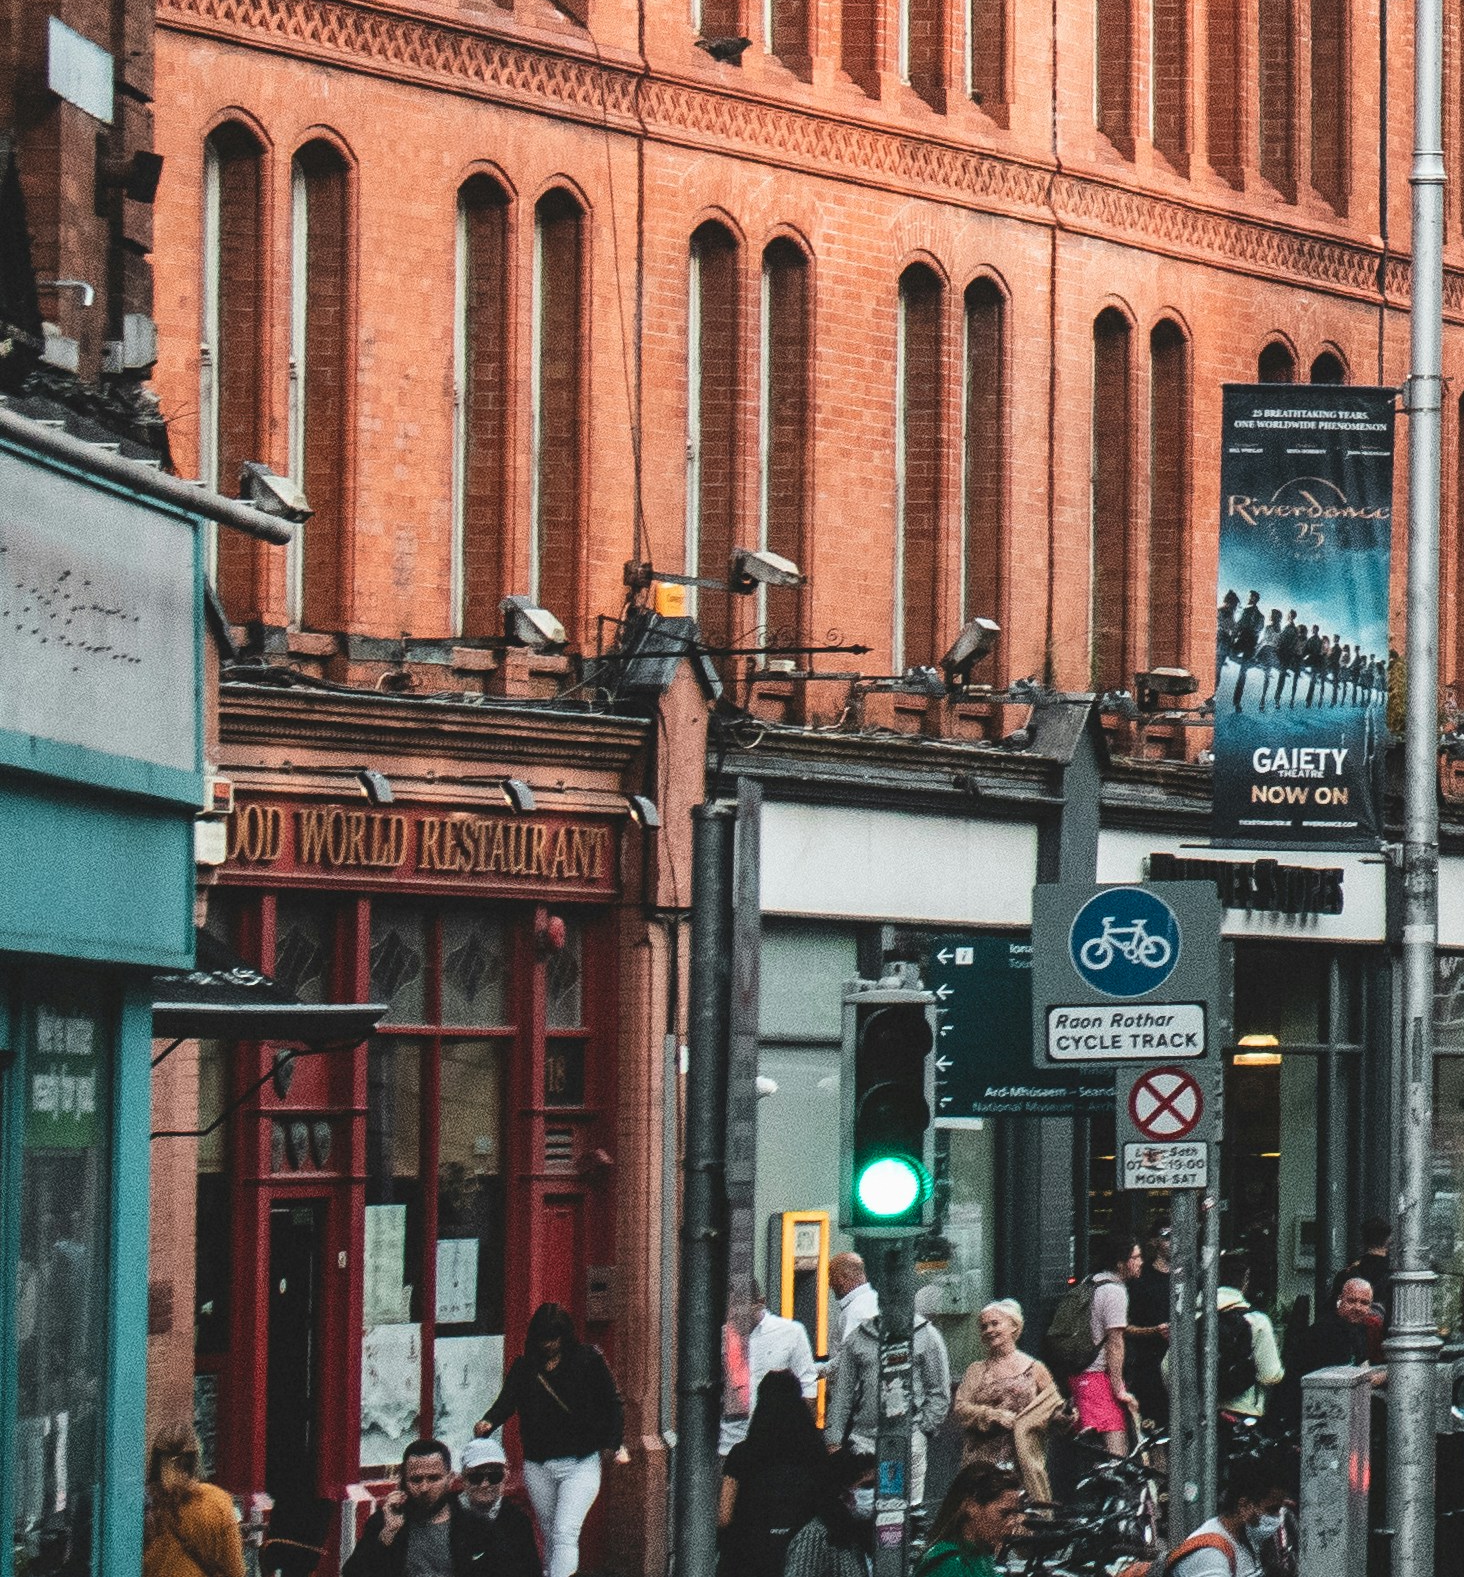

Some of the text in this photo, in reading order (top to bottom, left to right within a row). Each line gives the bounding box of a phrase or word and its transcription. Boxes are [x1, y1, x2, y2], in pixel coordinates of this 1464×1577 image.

[1234, 420, 1387, 431] ONE WORLDWIDE PHENOMENON
[1228, 489, 1390, 525] Riverdance
[1253, 747, 1349, 775] GAIETY
[1277, 769, 1325, 779] THEATRE
[1251, 785, 1350, 805] NOW ON
[229, 803, 609, 879] OD WORLD RESTAURANT
[1055, 1013, 1174, 1029] Raon Rothar
[1055, 1032, 1198, 1051] CYCLE TRACK
